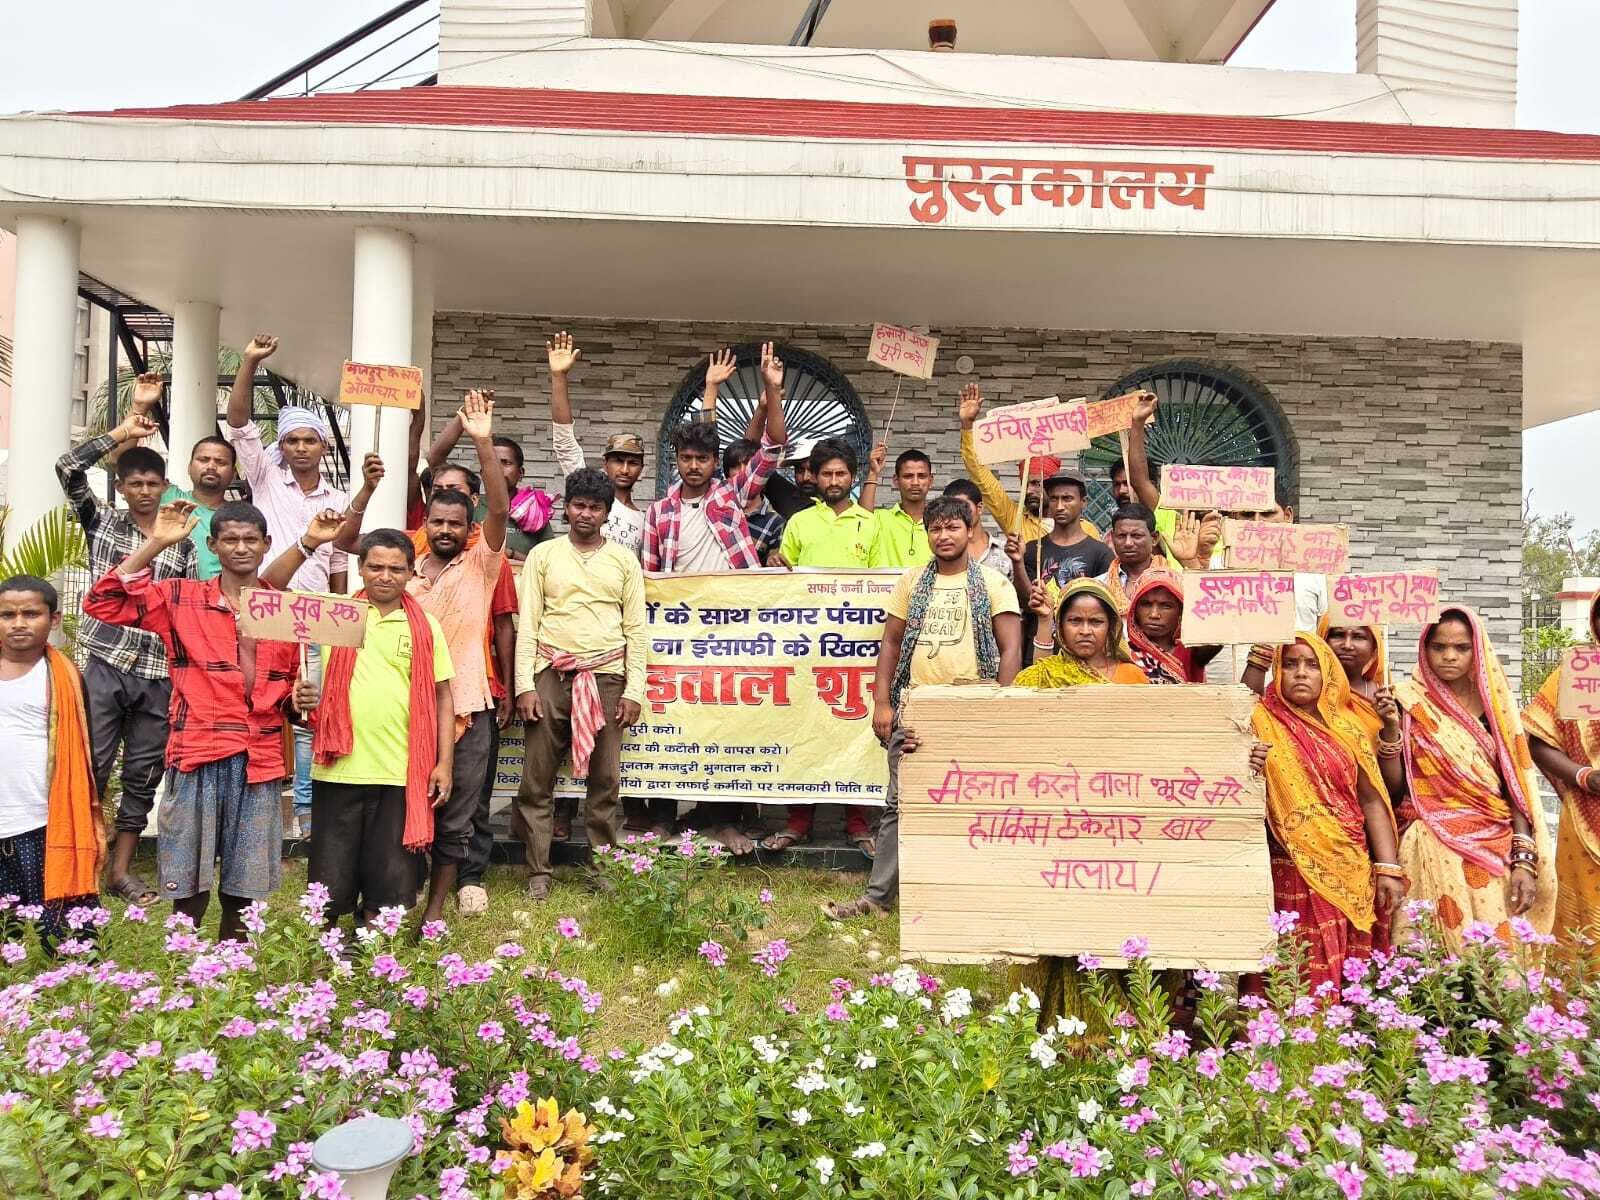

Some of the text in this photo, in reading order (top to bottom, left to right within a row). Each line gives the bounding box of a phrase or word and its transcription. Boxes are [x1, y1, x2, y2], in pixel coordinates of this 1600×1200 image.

[902, 156, 1215, 224] पुस्तकालय
[978, 414, 1033, 443] उचित
[807, 580, 838, 596] सफाई
[248, 591, 360, 627] हम सब एक
[664, 602, 692, 625] के
[699, 608, 749, 625] साथ
[758, 608, 820, 625] नगर
[652, 639, 684, 655] ना
[691, 633, 776, 659] इंसाफी
[783, 634, 812, 657] के
[646, 664, 795, 714] ड़ताल
[644, 743, 660, 754] की
[704, 743, 719, 754] को
[724, 745, 755, 755] वापस
[658, 761, 698, 774] मजदुरी
[704, 763, 745, 775] भुगतान
[497, 773, 523, 785] ठिके
[675, 778, 709, 791] सफाई
[757, 783, 773, 792] पर
[777, 781, 831, 792] दमनकारी
[928, 760, 1019, 803] मेहनत
[1027, 763, 1080, 802] करने
[1088, 772, 1143, 798] वाला
[1151, 766, 1204, 806] भूखे
[968, 807, 1053, 849] हाकिम
[1057, 809, 1146, 846] ठेकेदार
